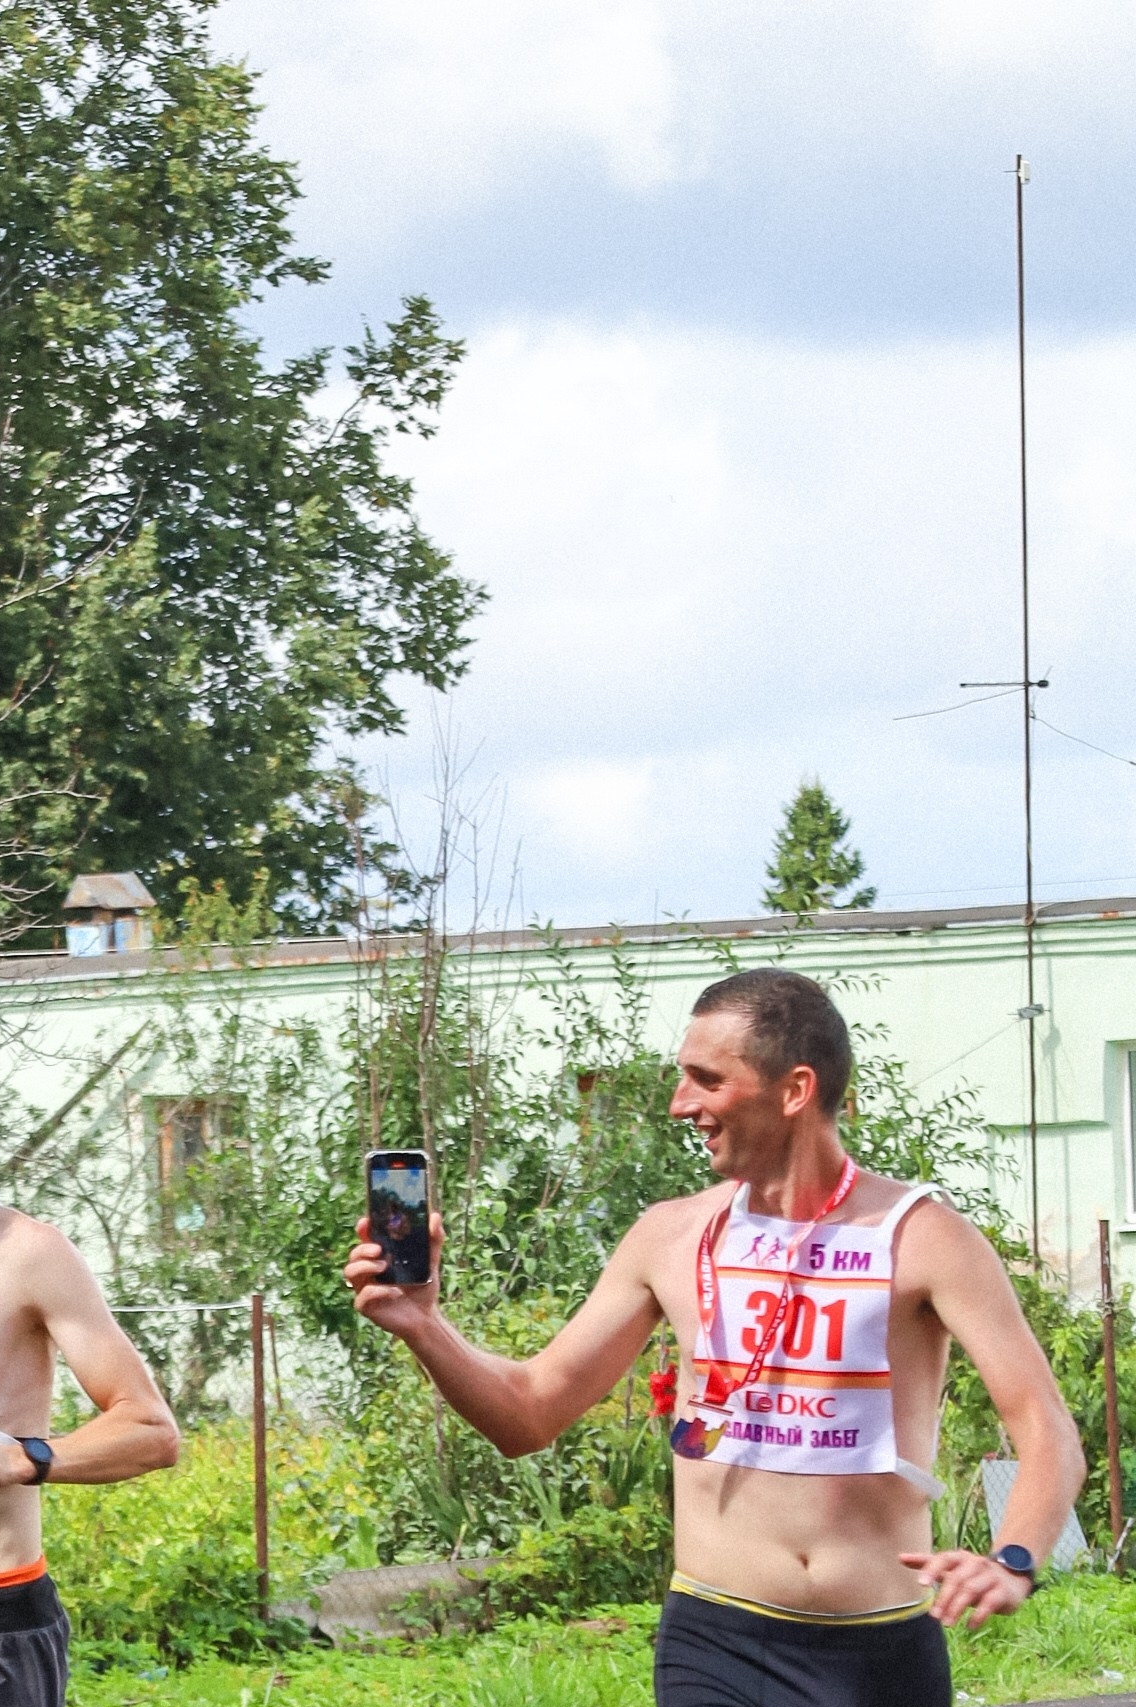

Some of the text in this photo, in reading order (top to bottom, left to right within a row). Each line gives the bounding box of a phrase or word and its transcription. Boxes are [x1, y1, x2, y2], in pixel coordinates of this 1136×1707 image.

[809, 1243, 872, 1272] 5 КМ
[741, 1290, 847, 1362] 301
[776, 1393, 837, 1418] DKC
[810, 1429, 860, 1449] ЗАБЕГ
